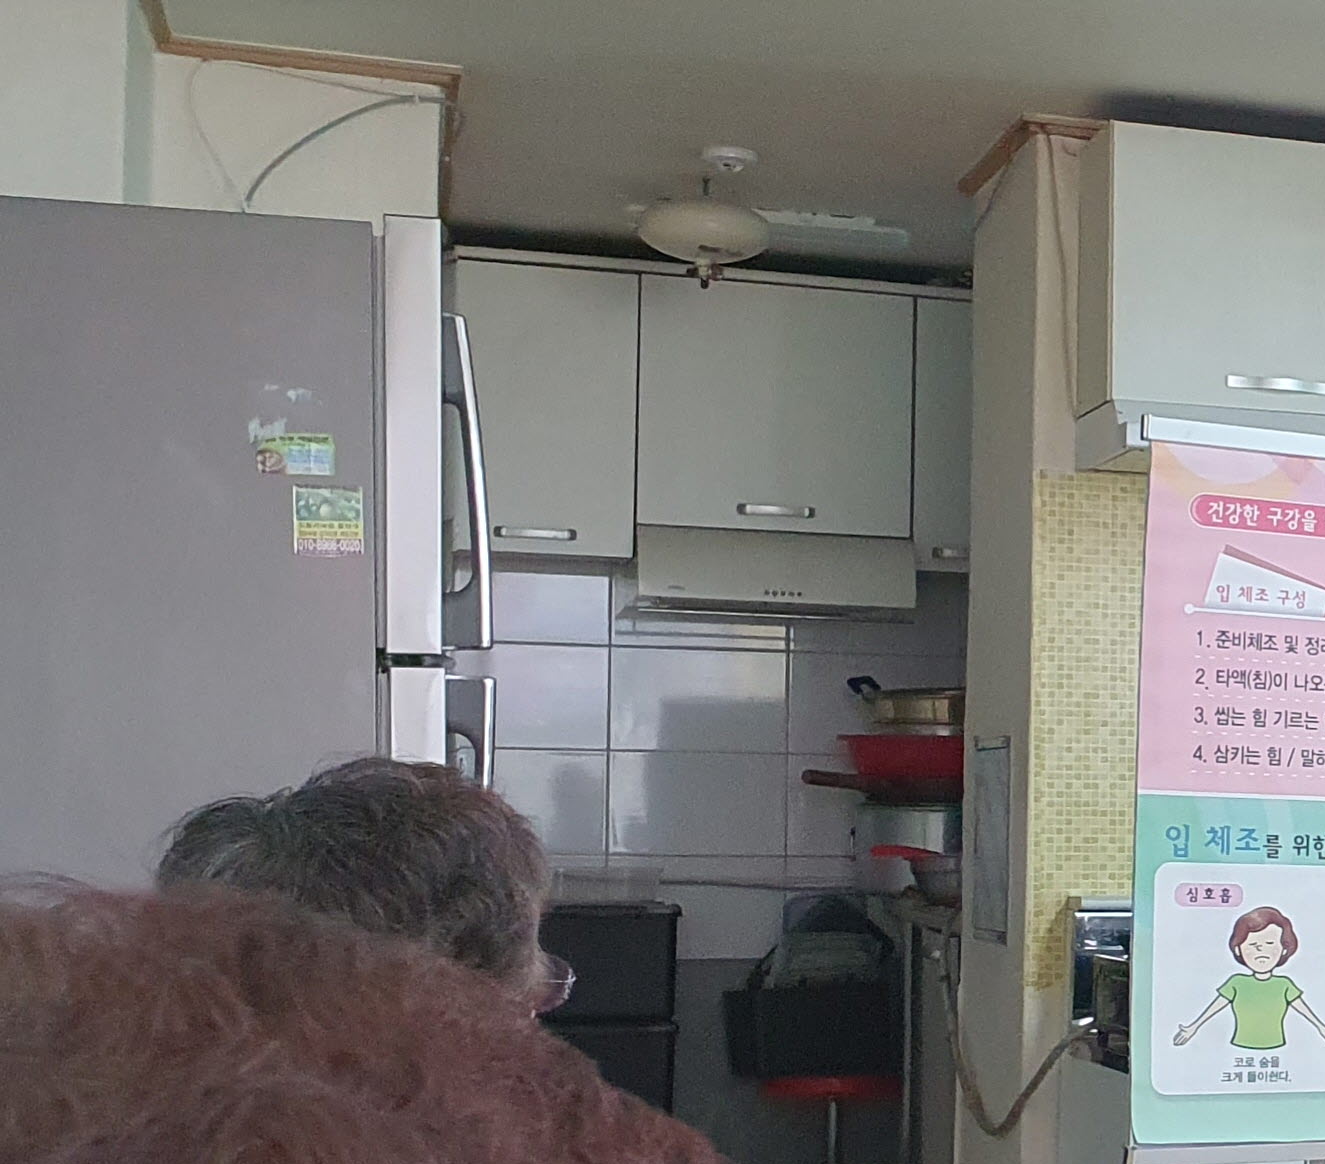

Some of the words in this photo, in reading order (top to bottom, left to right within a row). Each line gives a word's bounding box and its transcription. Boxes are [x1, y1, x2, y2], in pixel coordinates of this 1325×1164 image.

[1206, 501, 1260, 524] 건강한
[1267, 507, 1317, 531] 구강을
[1216, 585, 1229, 603] 입
[1238, 585, 1269, 603] 체조
[1277, 591, 1306, 609] 구성
[1196, 630, 1210, 648] 1.
[1215, 630, 1277, 651] 준비체조
[1284, 635, 1298, 652] 및
[1195, 668, 1209, 690] 2.
[1216, 669, 1288, 691] 타액(침)이
[1194, 706, 1208, 724] 3.
[1214, 706, 1245, 727] 씹는
[1253, 710, 1267, 728] 힘
[1273, 711, 1318, 730] 기르는
[1193, 745, 1207, 763] 4.
[1214, 745, 1260, 765] 삼키는
[1268, 748, 1281, 766] 힘
[1286, 748, 1295, 766] /
[1165, 824, 1191, 858] 입
[1205, 825, 1282, 859] 체조를
[1186, 887, 1232, 903] 심호흡
[1233, 1057, 1256, 1067] 코로
[1221, 1072, 1242, 1082] 크게
